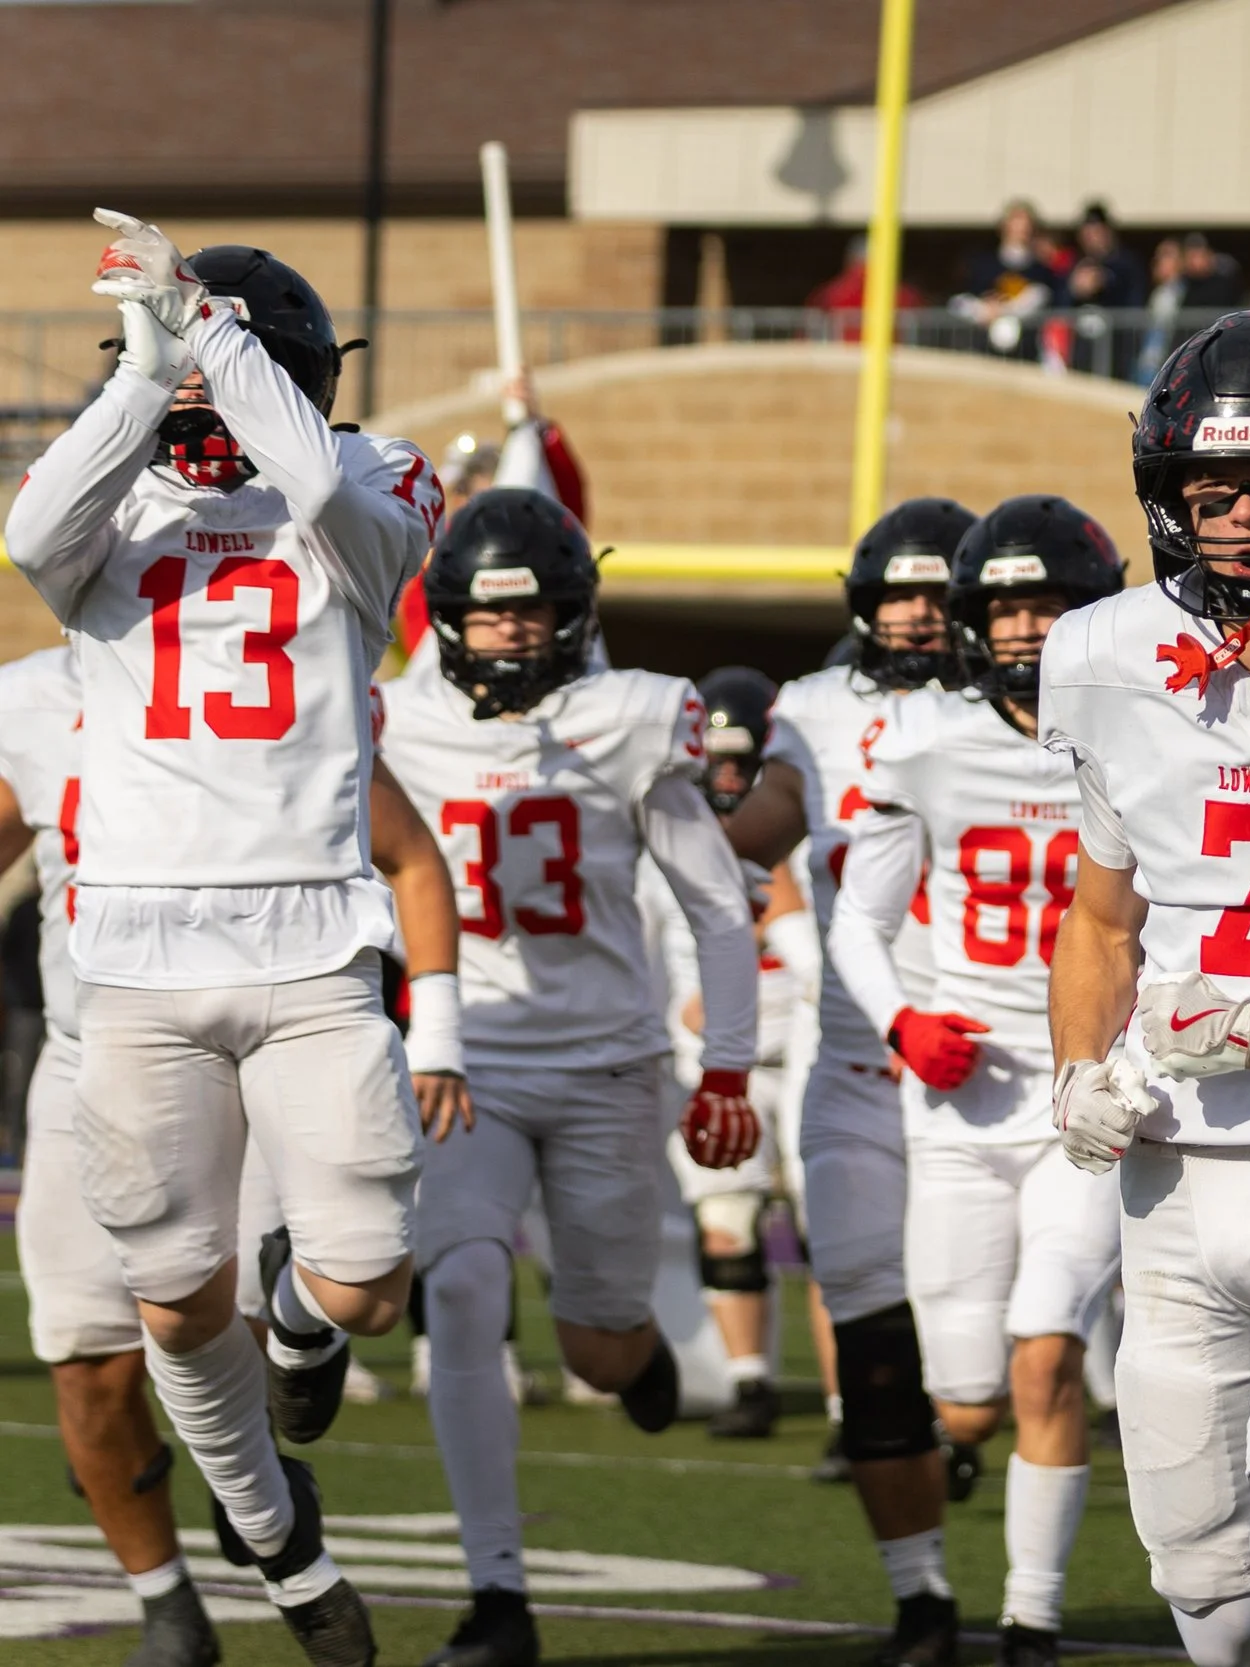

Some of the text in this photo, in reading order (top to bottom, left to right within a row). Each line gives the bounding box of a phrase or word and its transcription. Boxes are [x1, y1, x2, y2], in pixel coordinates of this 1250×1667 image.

[184, 530, 255, 553] LOWELL
[137, 555, 300, 740] 13
[1009, 800, 1071, 820] LOWELL
[440, 794, 585, 940] 33
